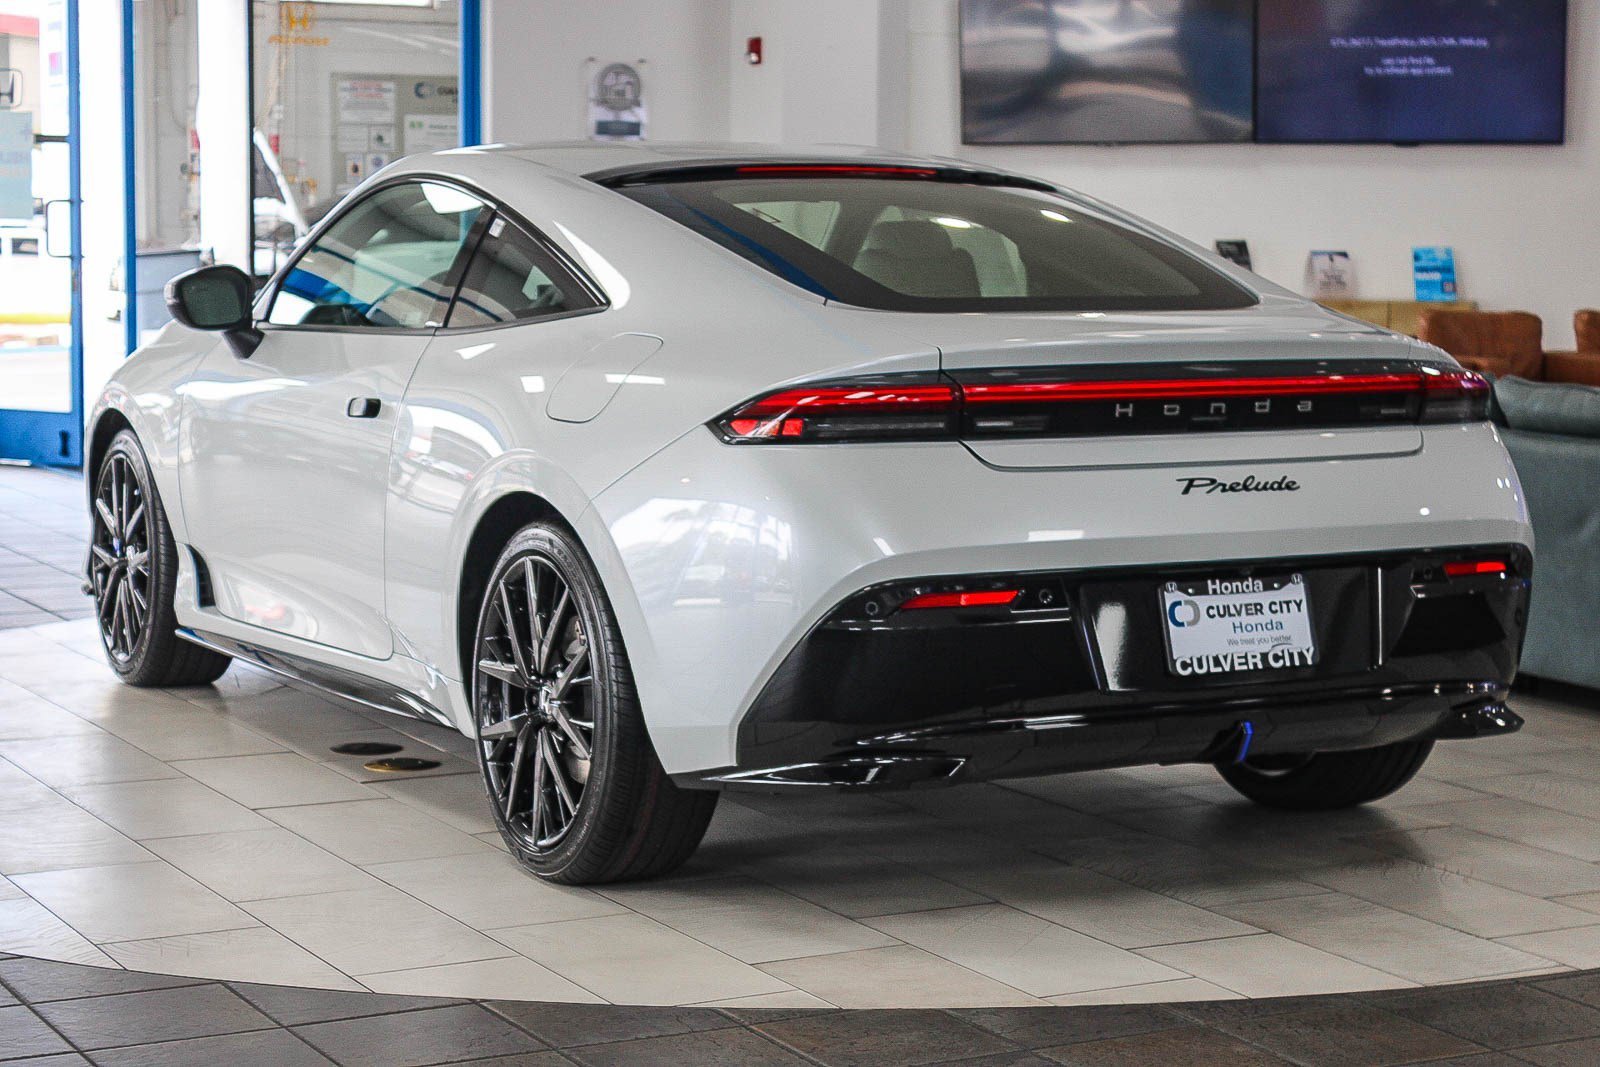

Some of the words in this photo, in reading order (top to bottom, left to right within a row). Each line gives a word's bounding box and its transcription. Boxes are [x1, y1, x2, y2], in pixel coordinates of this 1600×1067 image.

[1115, 399, 1313, 417] Honda
[1176, 475, 1300, 495] Prelude
[1207, 577, 1263, 594] Honda
[1206, 603, 1264, 618] CULVER
[1268, 599, 1303, 614] CITY
[1231, 619, 1284, 634] Honda
[1226, 638, 1239, 647] We
[1256, 637, 1270, 646] you
[1175, 651, 1263, 676] CULVER
[1268, 645, 1314, 669] CITY
